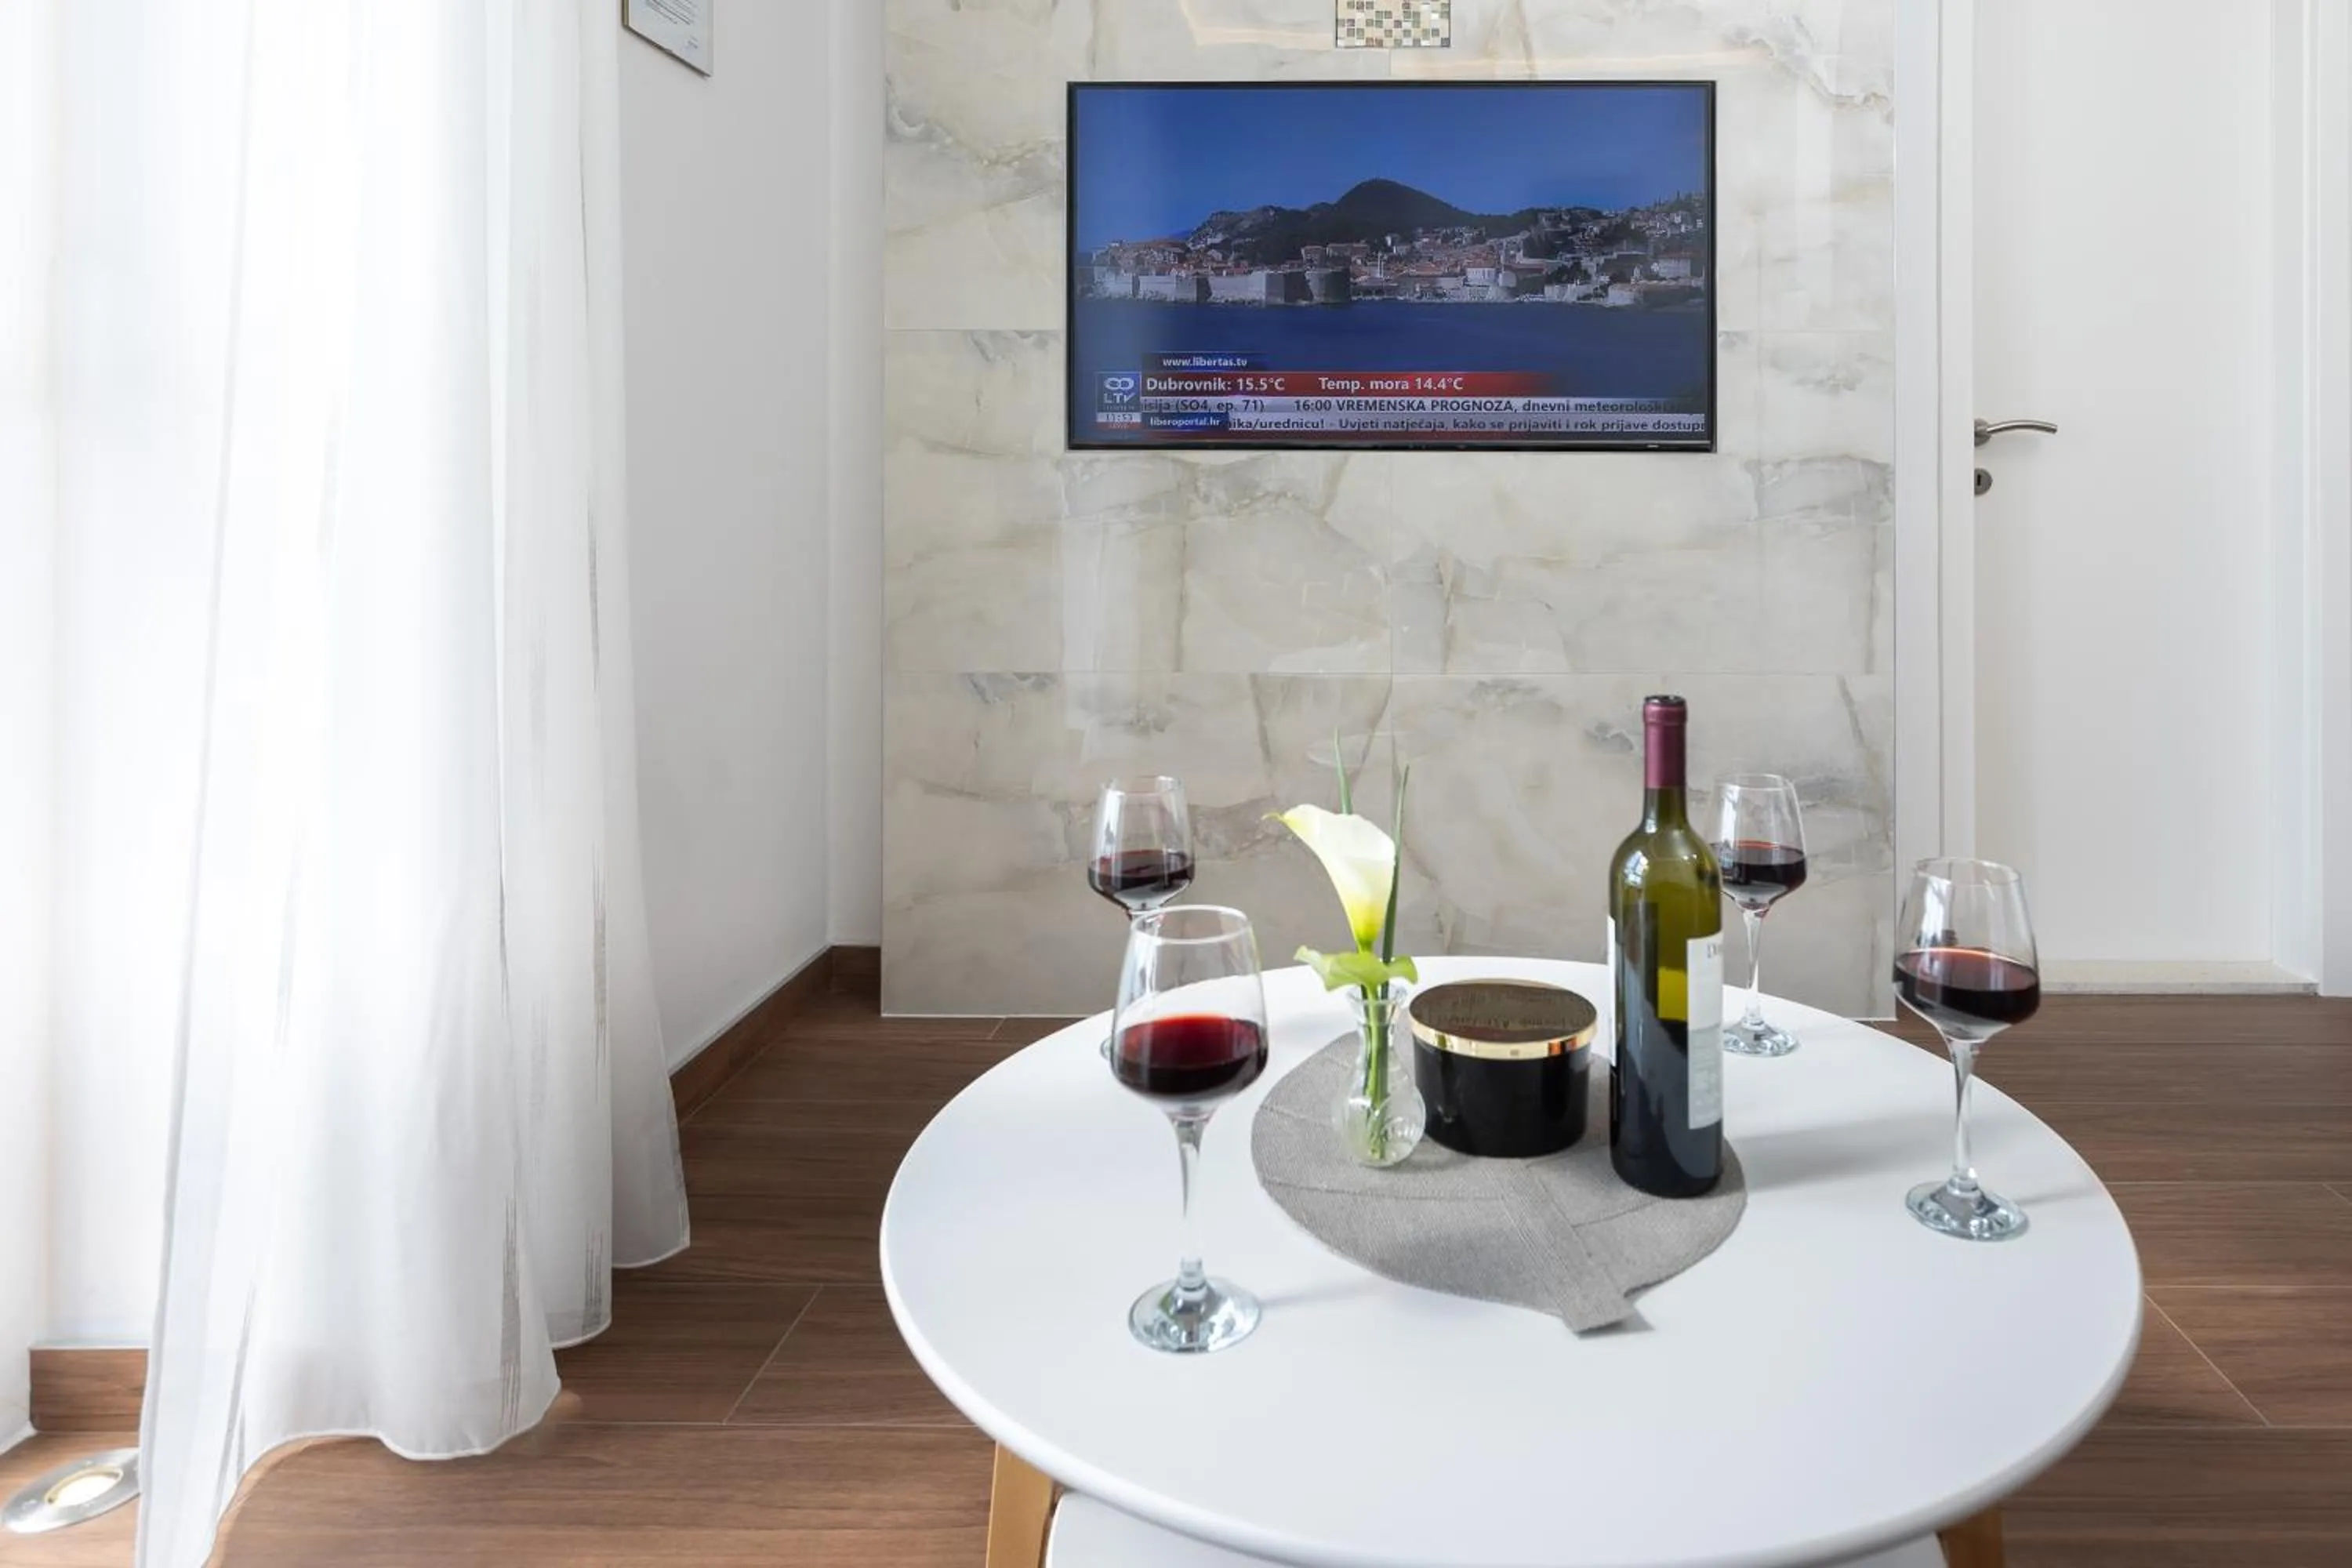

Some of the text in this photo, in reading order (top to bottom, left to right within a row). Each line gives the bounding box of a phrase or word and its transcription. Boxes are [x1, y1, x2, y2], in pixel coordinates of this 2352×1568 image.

[1163, 357, 1247, 367] www.libertas.tv
[1147, 377, 1285, 390] Dubrovnik: 15.5°C
[1319, 377, 1464, 394] Temp. mora 14.4°C
[1103, 392, 1136, 405] LTV
[1217, 403, 1237, 412] ep.
[1242, 399, 1265, 413] 71)
[1294, 400, 1332, 412] 16:00
[1336, 400, 1426, 412] VREMENSKA
[1431, 400, 1518, 413] PROGNOZA,
[1523, 400, 1570, 412] dnevni
[1150, 417, 1220, 427] liberoportal.hr
[1339, 419, 1378, 431] Uvjeti
[1453, 419, 1486, 429] kako
[1508, 419, 1562, 432] prijaviti
[1575, 419, 1596, 430] rok
[1601, 419, 1648, 432] prijave
